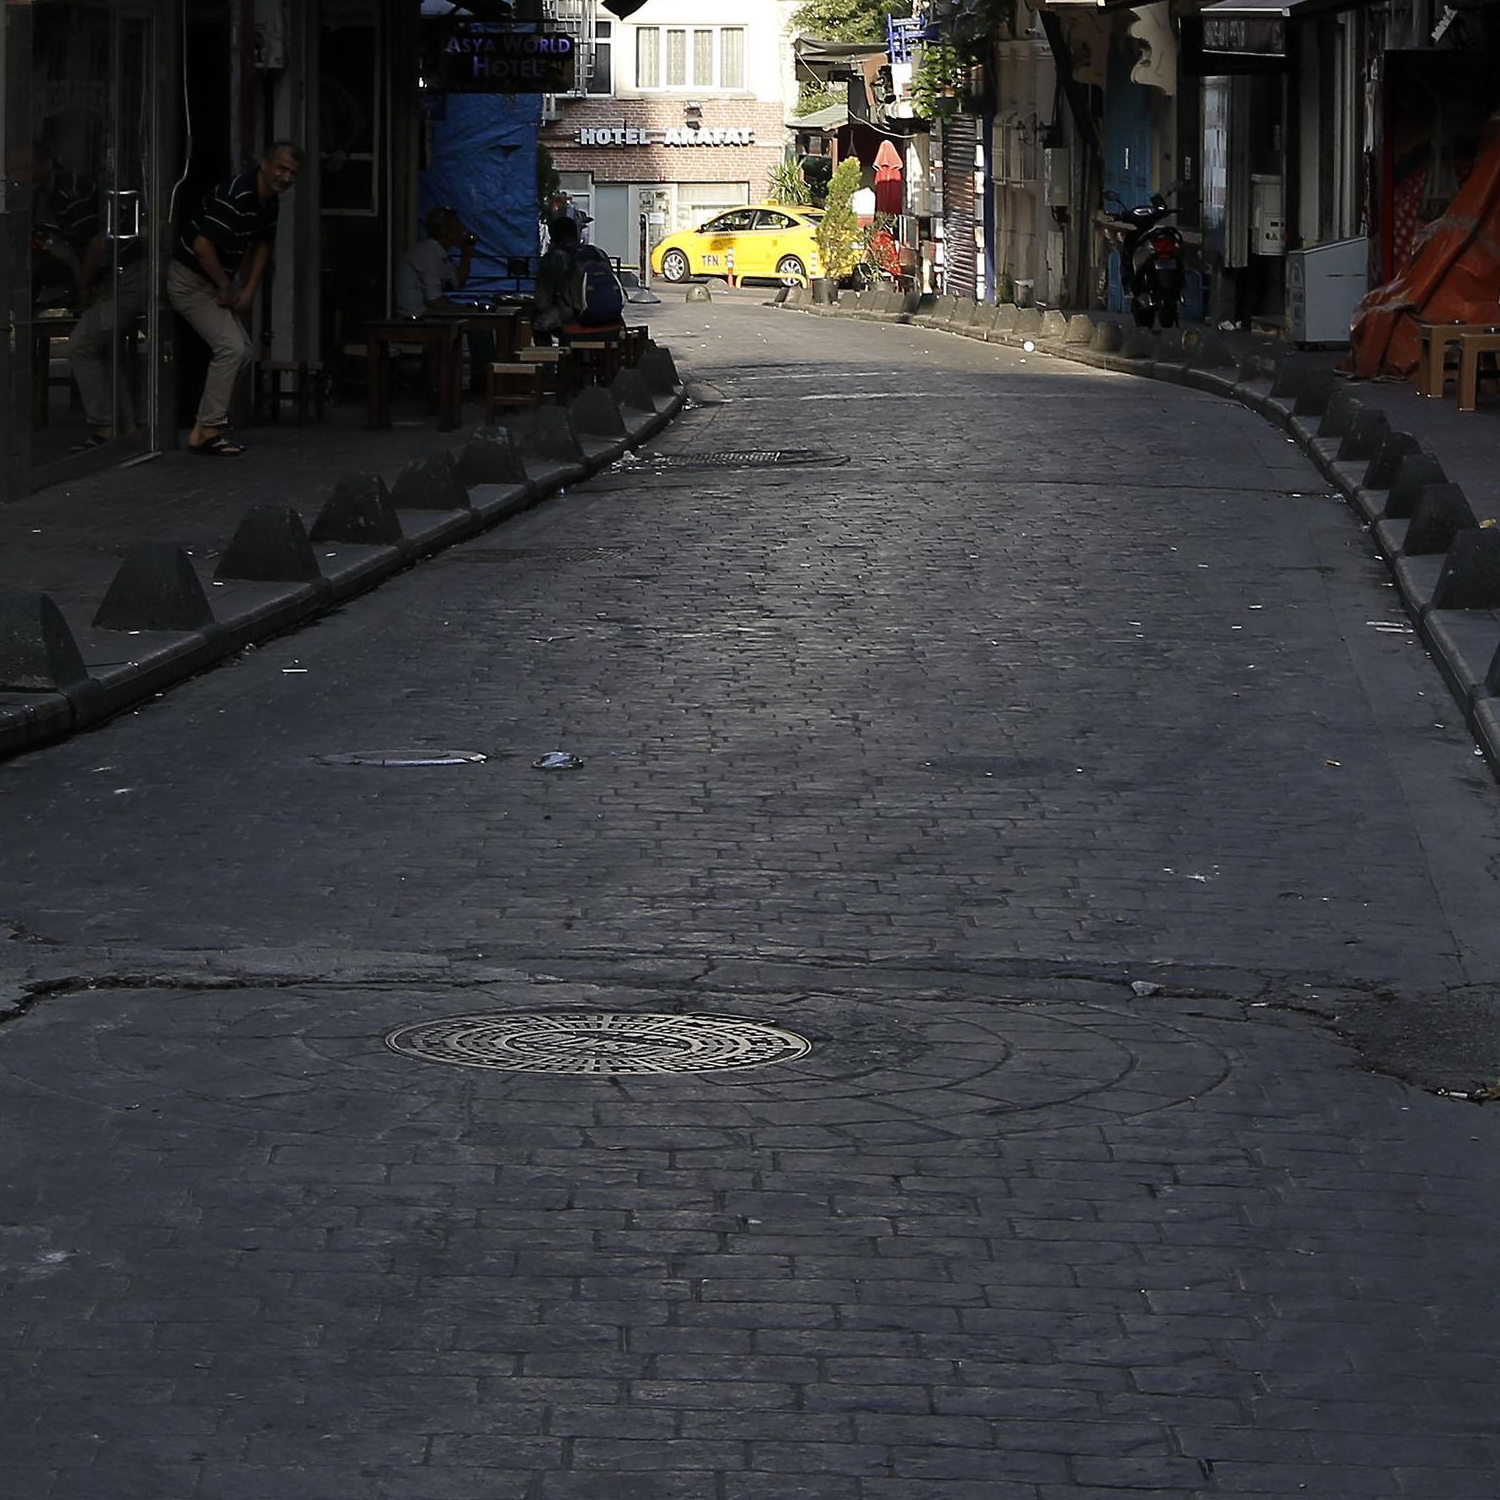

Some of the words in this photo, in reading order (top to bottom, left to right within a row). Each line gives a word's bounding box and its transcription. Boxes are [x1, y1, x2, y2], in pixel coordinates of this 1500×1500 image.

[445, 35, 497, 53] ASYA
[501, 35, 571, 53] WORLD
[579, 127, 651, 147] HOTEL
[663, 127, 752, 148] ARAFAT
